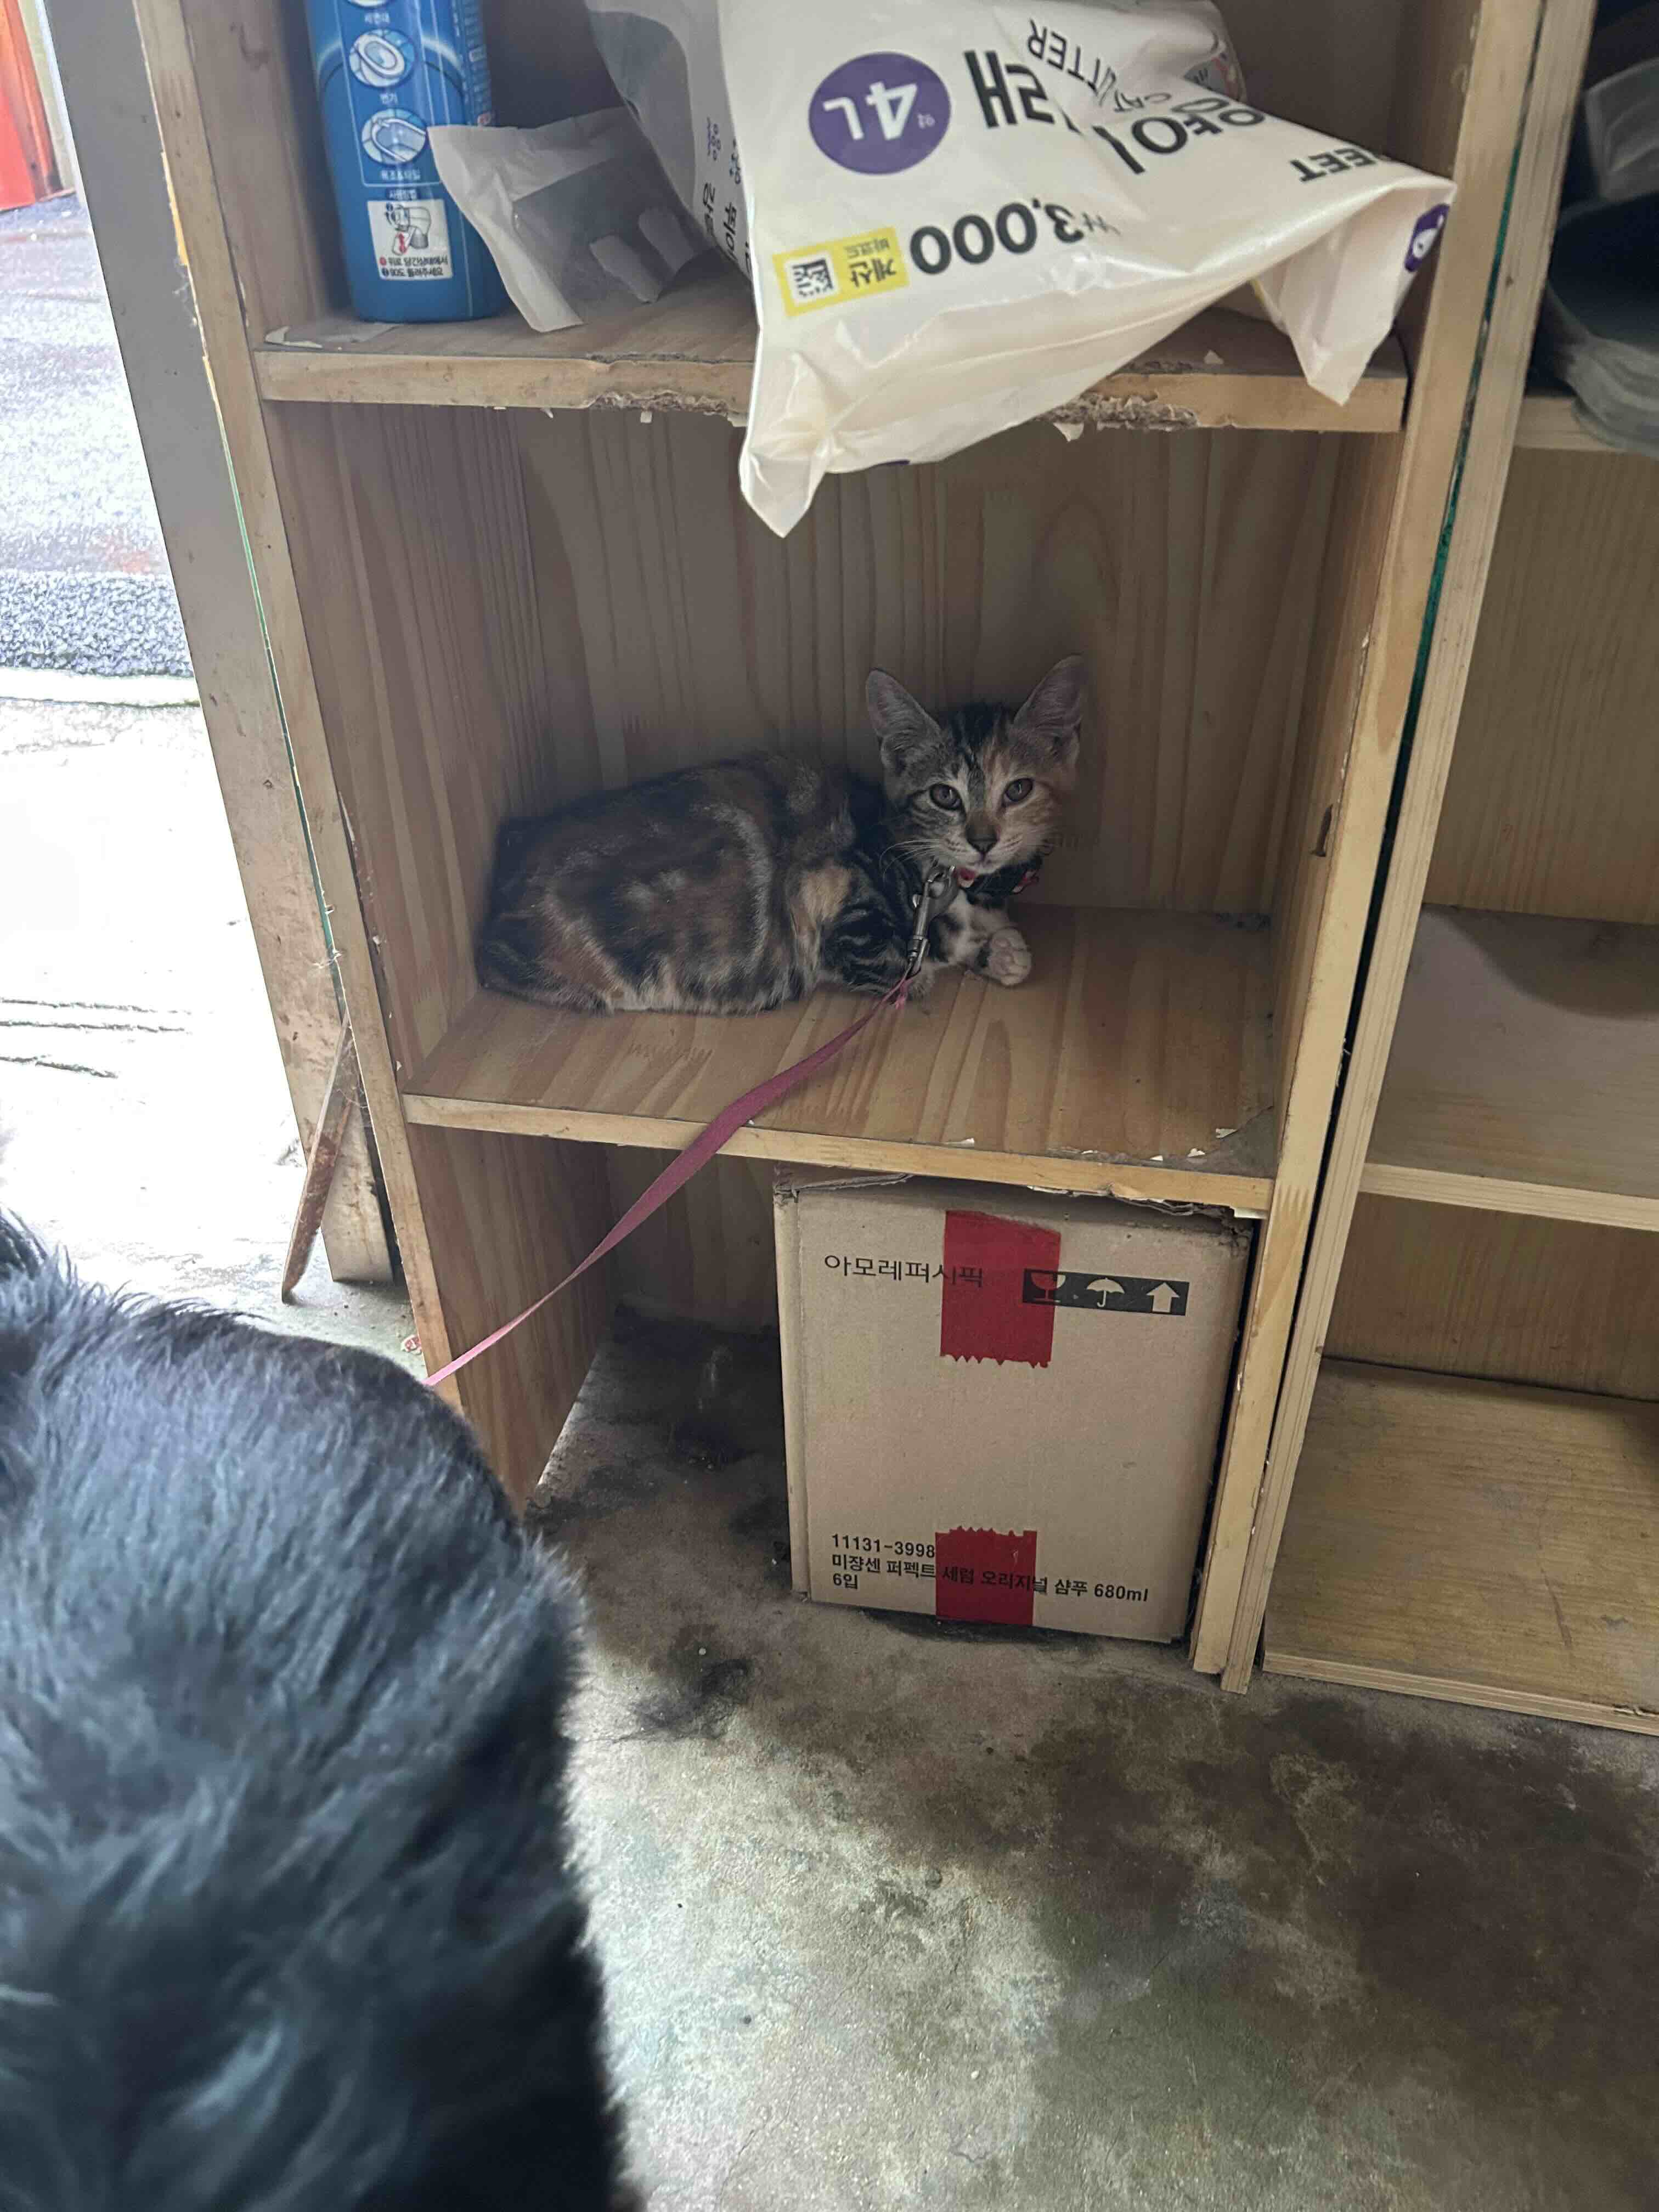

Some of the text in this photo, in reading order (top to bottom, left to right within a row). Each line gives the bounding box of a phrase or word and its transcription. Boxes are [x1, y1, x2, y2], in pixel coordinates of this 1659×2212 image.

[822, 81, 918, 140] 4L
[963, 50, 1265, 175] 양이 래
[1289, 147, 1381, 183] EET
[848, 258, 898, 287] 계산
[825, 1255, 983, 1288] 아모레퍼시픽
[832, 1533, 935, 1558] 11131-3998
[832, 1554, 1148, 1602] 미쟝센 퍼펙트 세럼 오리지널 샴푸 680ml
[833, 1573, 859, 1590] 6입
